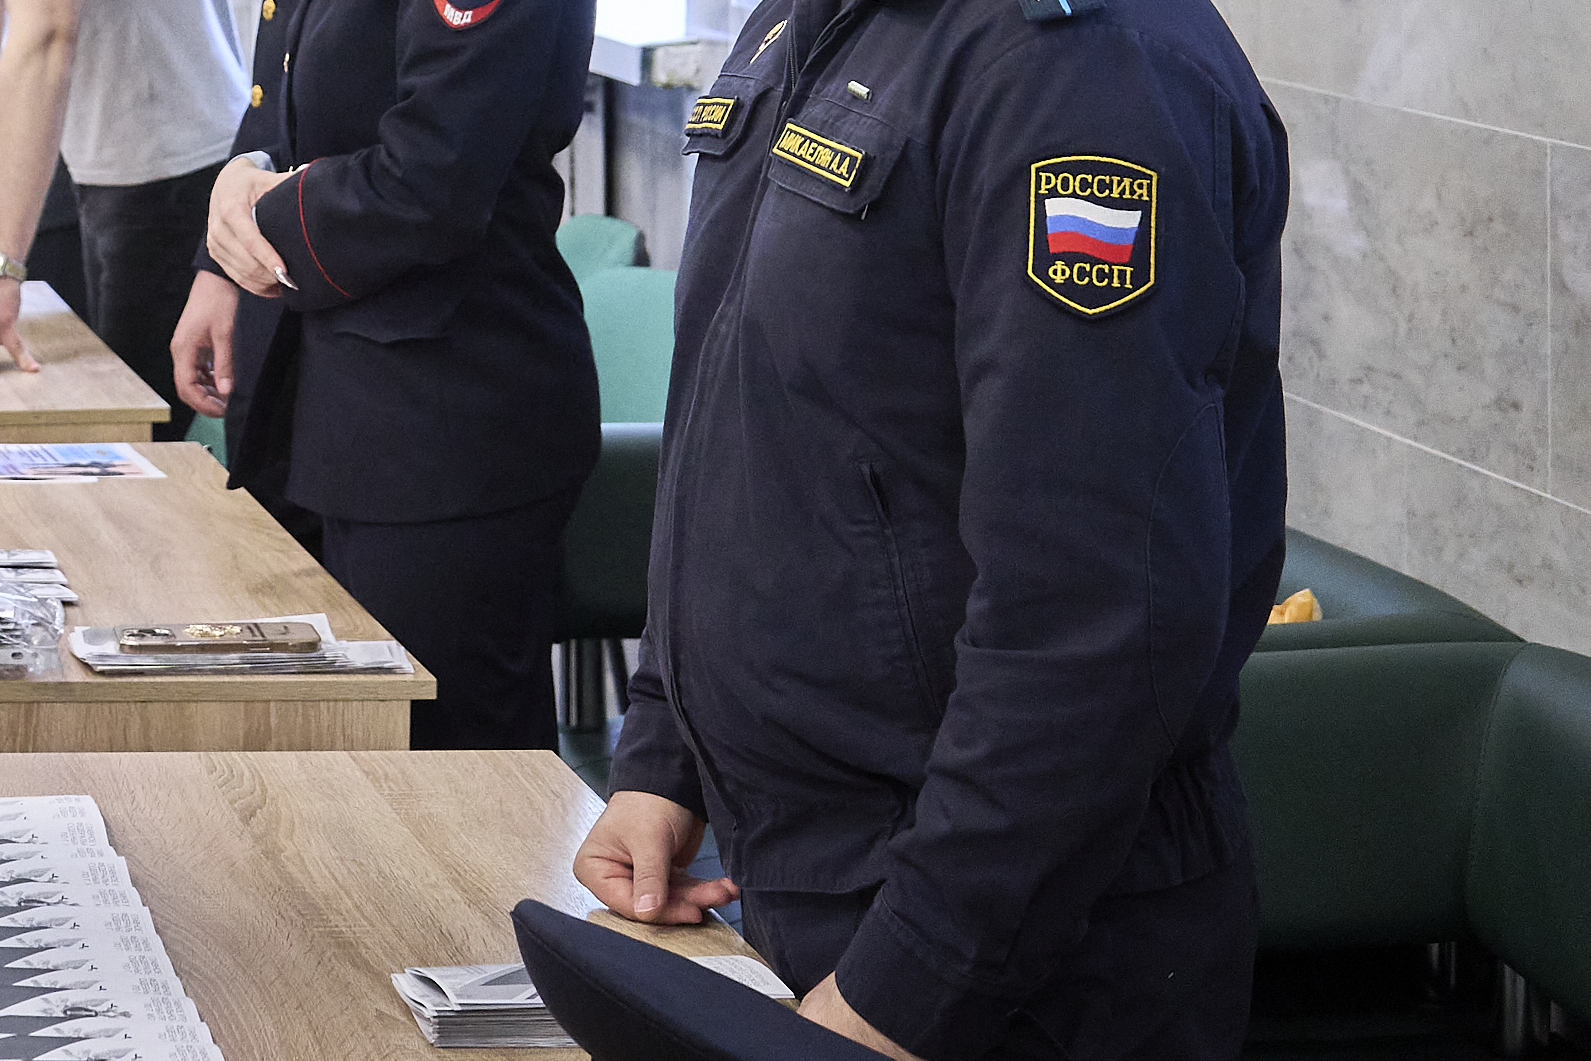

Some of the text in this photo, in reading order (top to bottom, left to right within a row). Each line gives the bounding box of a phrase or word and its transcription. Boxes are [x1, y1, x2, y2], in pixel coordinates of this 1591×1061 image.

[443, 3, 474, 26] МВД
[1038, 172, 1151, 201] РОССИЯ
[1048, 260, 1134, 289] ФССП
